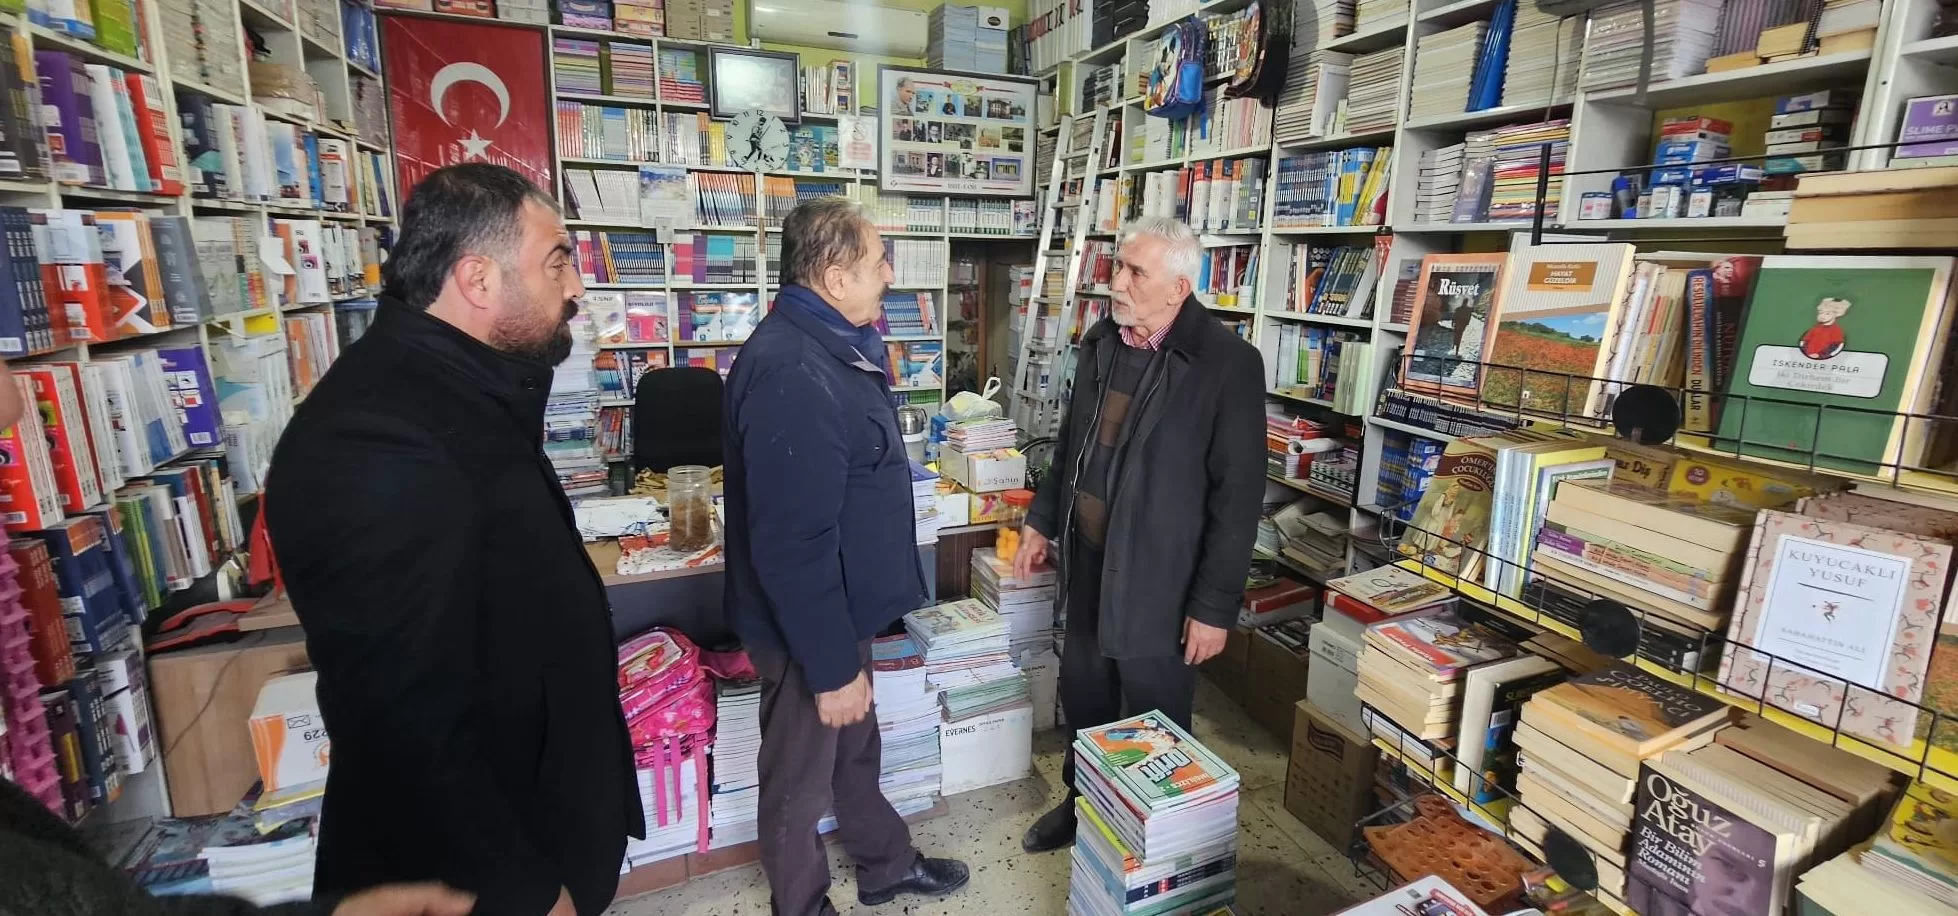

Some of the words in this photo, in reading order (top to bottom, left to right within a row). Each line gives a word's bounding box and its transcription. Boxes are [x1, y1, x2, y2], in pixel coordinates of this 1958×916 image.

[742, 110, 750, 118] 11
[756, 109, 764, 117] 12
[1437, 278, 1480, 297] Rüşvet
[1831, 363, 1860, 373] PALA
[1788, 549, 1897, 580] KUYUCAKLI
[1809, 567, 1869, 588] YUSUF
[1610, 669, 1703, 712] COELHO
[945, 725, 976, 737] EVERNES
[1646, 773, 1733, 838] Oğuz
[1640, 799, 1717, 857] Atay
[1638, 838, 1706, 884] Adamının
[1640, 826, 1663, 845] Bir
[1663, 840, 1702, 870] Bilim
[1637, 848, 1690, 885] Romanı
